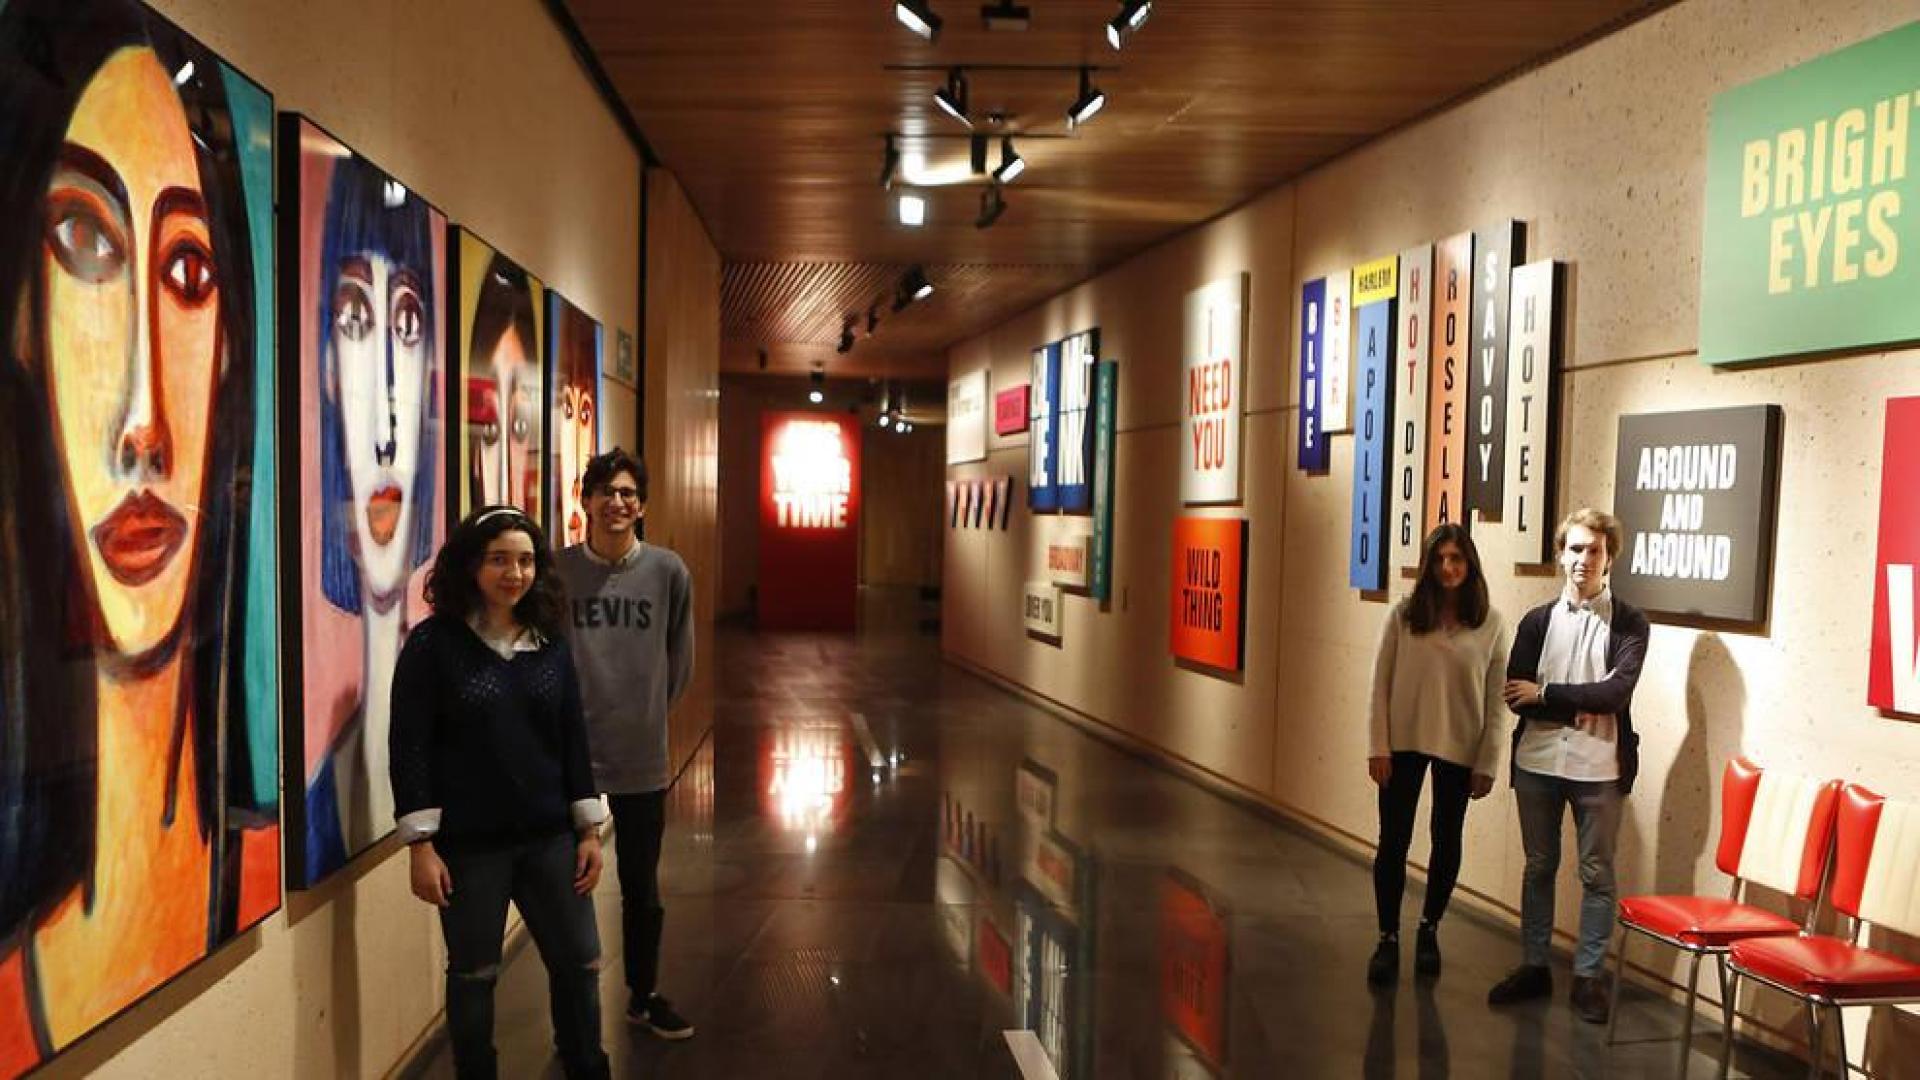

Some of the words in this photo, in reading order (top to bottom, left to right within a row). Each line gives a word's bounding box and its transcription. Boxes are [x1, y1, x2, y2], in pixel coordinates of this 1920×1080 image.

[1768, 190, 1901, 295] EYES
[1406, 268, 1420, 396] HOT
[1190, 358, 1231, 416] NEED
[1305, 302, 1319, 449] BLUE
[1479, 251, 1497, 482] SAVOY
[1438, 269, 1458, 524] ROSELA
[1517, 294, 1536, 532] HOTEL
[1193, 417, 1226, 471] YOU
[1359, 326, 1377, 565] APOLLO
[1636, 444, 1737, 490] AROUND
[772, 491, 849, 528] TIME
[1401, 421, 1415, 546] DOG
[1660, 494, 1703, 530] AND
[1186, 547, 1220, 589] WILD
[1631, 532, 1731, 580] AROUND
[572, 599, 652, 629] LEVI'S
[1183, 588, 1222, 632] THING
